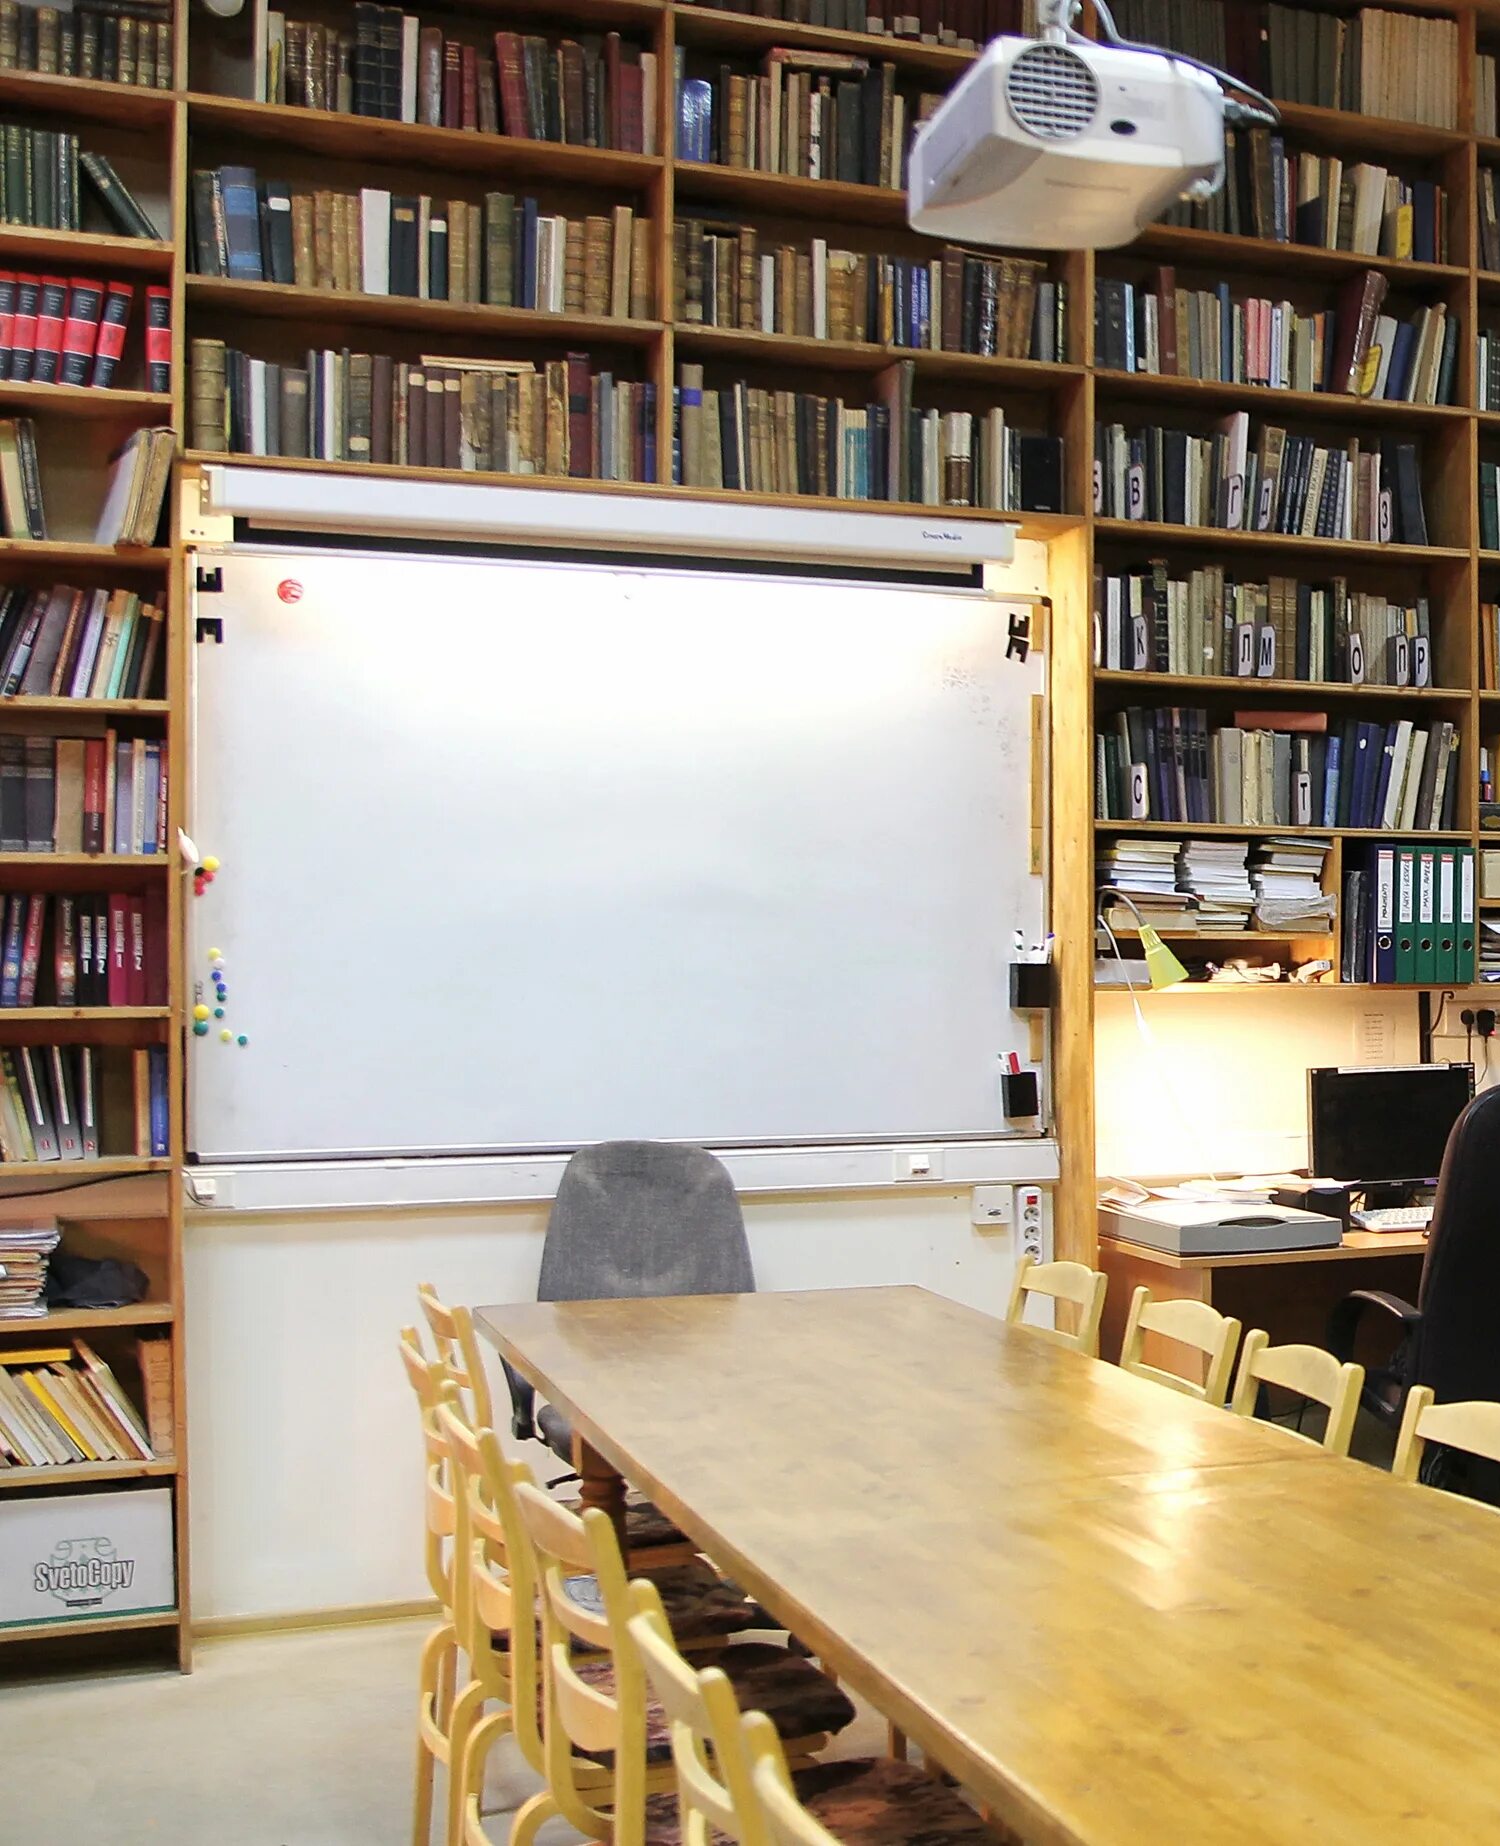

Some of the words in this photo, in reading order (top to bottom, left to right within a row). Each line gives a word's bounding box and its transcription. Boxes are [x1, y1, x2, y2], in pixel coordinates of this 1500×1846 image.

[1230, 485, 1240, 514] Г
[1136, 625, 1145, 656] К
[1260, 637, 1272, 666] М
[1398, 644, 1406, 673] П
[1417, 646, 1425, 675] Р
[1300, 782, 1308, 811] Т
[34, 1557, 135, 1593] SvetoCopy
